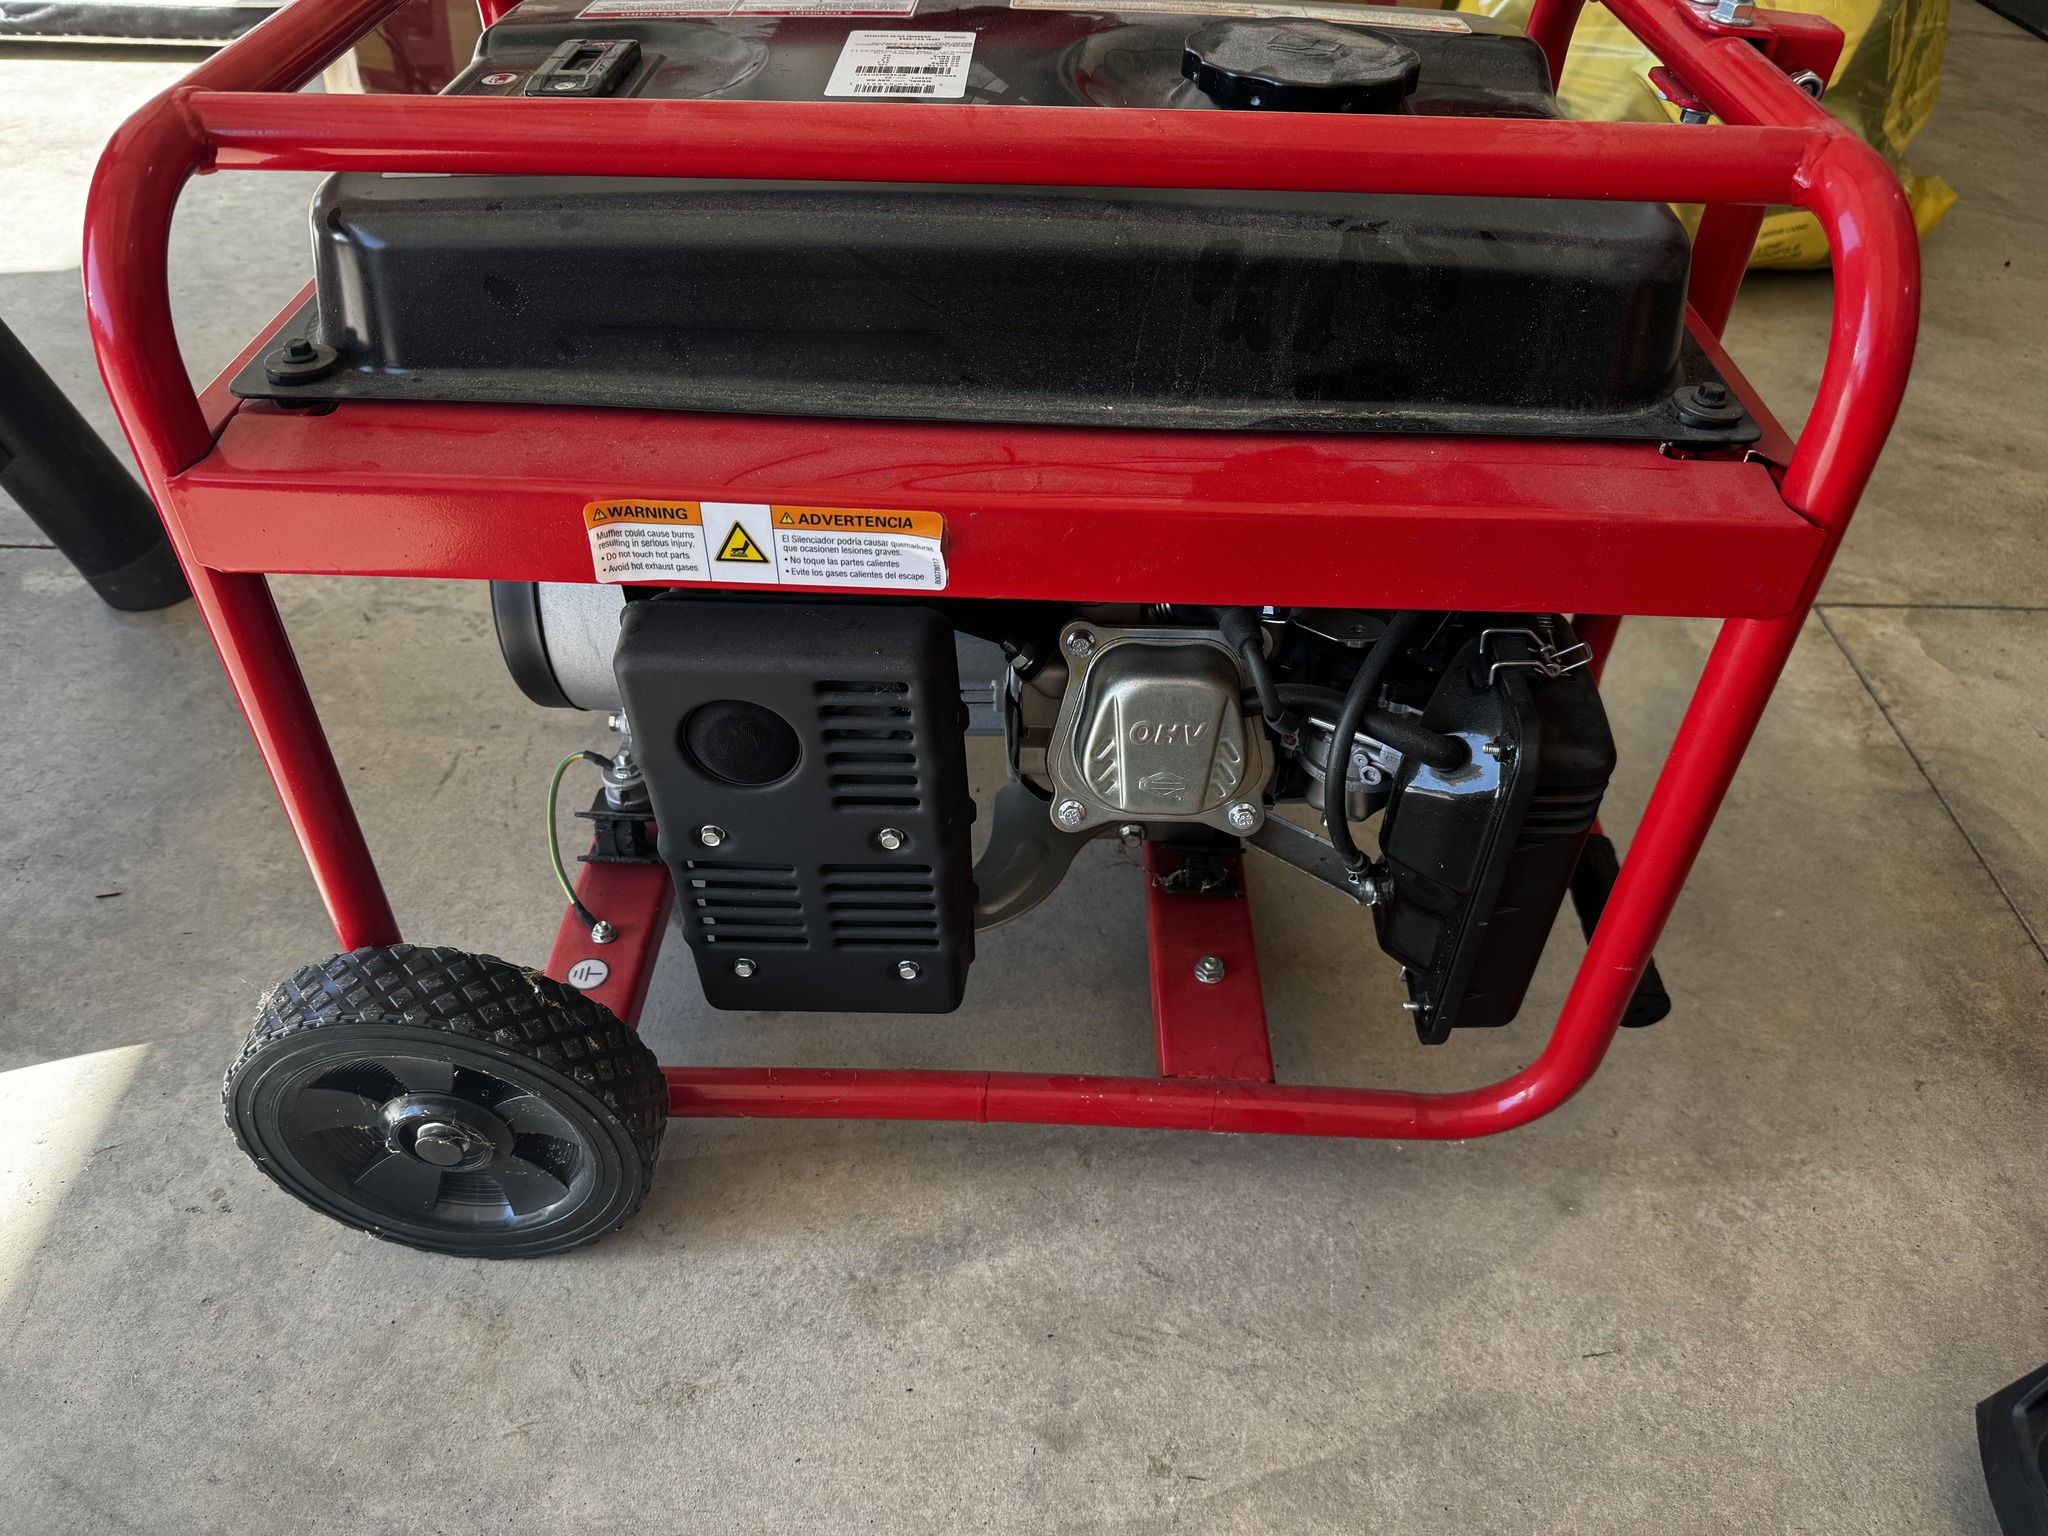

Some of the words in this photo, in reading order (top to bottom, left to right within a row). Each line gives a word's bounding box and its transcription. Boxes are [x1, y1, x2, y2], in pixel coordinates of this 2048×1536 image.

[607, 505, 688, 520] WARNING
[798, 513, 913, 529] ADVERTENCIA
[596, 529, 623, 541] Muffler
[624, 528, 646, 538] could
[646, 530, 670, 538] cause
[671, 529, 695, 539] burns
[782, 534, 790, 543] El
[791, 534, 835, 545] Silenciador
[837, 536, 862, 548] podría
[863, 539, 889, 547] causar
[598, 538, 631, 550] resulting
[632, 538, 640, 548] in
[640, 538, 670, 548] serious
[670, 538, 696, 550] injury.
[606, 552, 617, 561] Do
[618, 550, 631, 558] not
[632, 550, 654, 558] touch
[655, 550, 669, 559] hot
[670, 551, 690, 561] parts
[783, 545, 798, 554] que
[799, 545, 839, 554] ocasionen
[841, 545, 873, 556] lesiones
[874, 548, 903, 558] graves.
[608, 562, 630, 573] Avoid
[630, 561, 643, 570] hot
[644, 561, 674, 571] exhaust
[675, 563, 699, 573] gases
[790, 556, 801, 564] No
[803, 557, 826, 567] toque
[827, 557, 839, 566] las
[840, 558, 865, 568] partes
[865, 558, 900, 568] calientes
[791, 567, 810, 577] Evite
[811, 568, 824, 577] los
[825, 569, 848, 579] gases
[849, 570, 883, 580] calientes
[884, 571, 897, 580] del
[898, 573, 925, 583] escape
[1129, 720, 1209, 746] OHV
